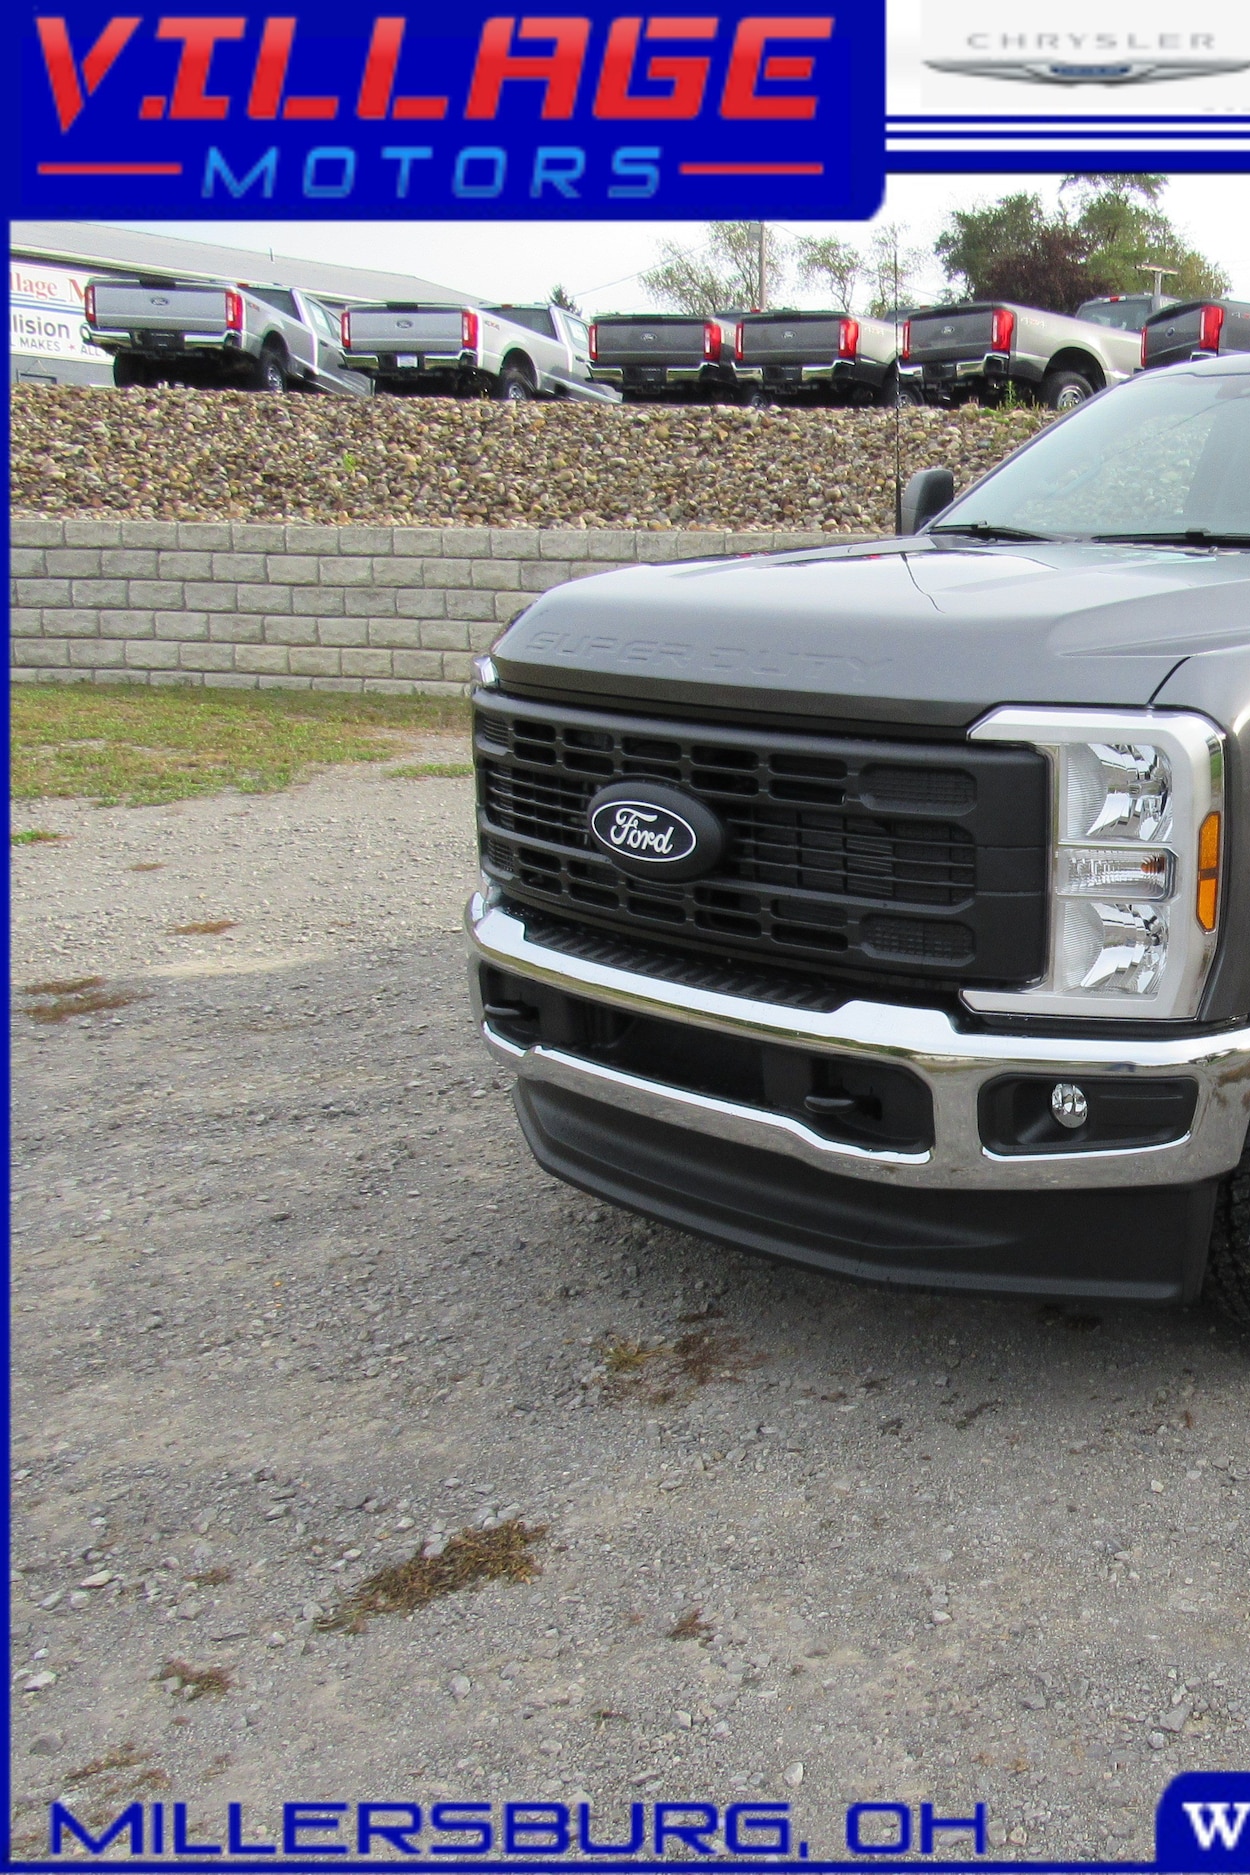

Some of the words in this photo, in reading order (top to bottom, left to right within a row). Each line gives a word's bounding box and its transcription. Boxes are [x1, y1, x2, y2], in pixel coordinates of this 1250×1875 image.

[20, 337, 61, 352] MAKES
[525, 630, 692, 671] SUPER
[702, 645, 893, 683] DUTY
[610, 808, 674, 854] Ford
